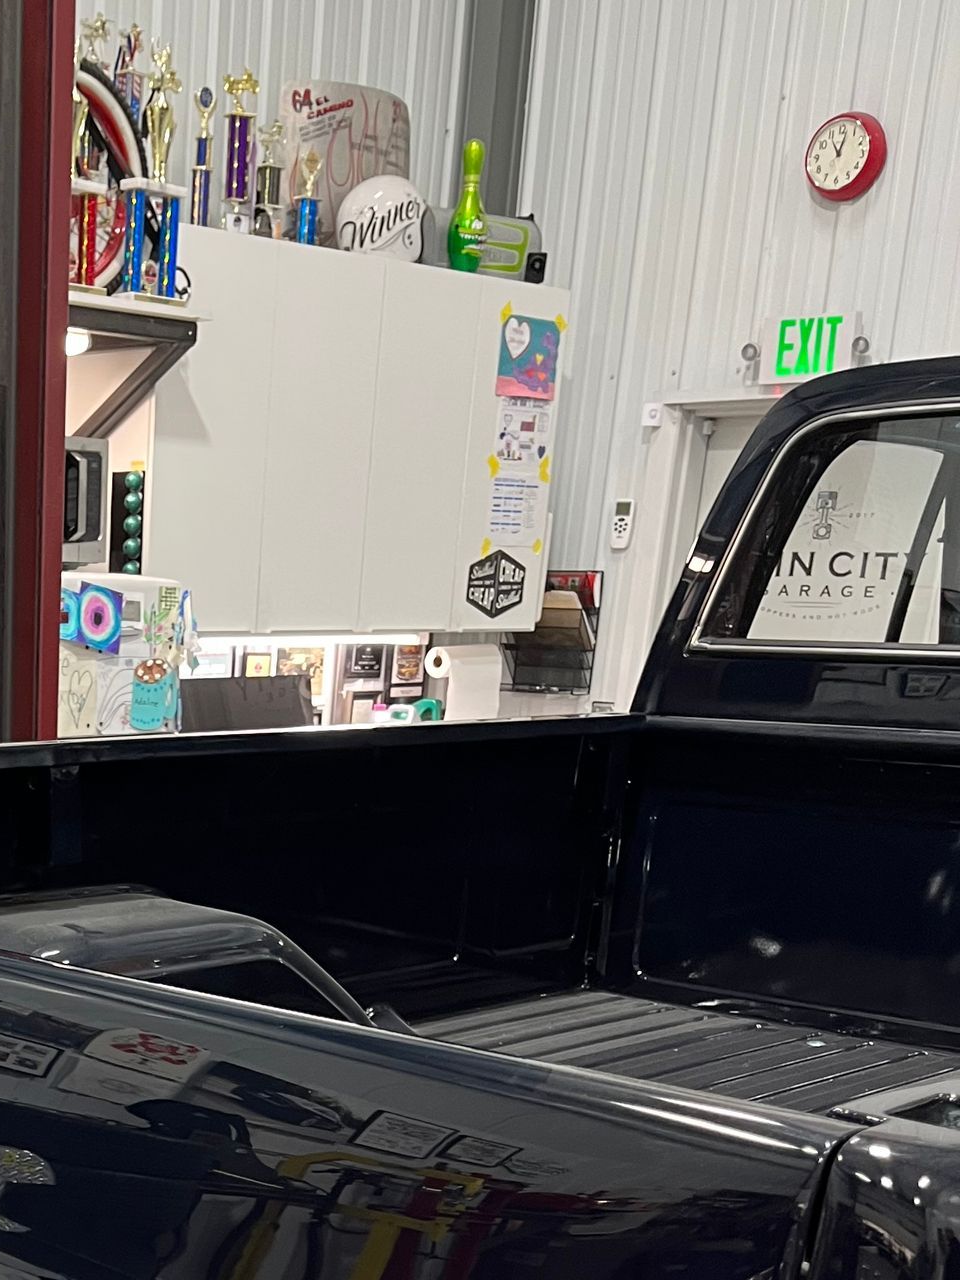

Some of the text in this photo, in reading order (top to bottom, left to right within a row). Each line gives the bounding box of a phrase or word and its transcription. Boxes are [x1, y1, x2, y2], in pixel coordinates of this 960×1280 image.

[292, 88, 313, 113] 64
[307, 99, 354, 120] CAMINO
[339, 198, 421, 249] Winner
[775, 316, 844, 376] EXIT
[499, 559, 525, 583] CHEAP
[773, 549, 816, 578] IN
[468, 587, 495, 610] CHEAP
